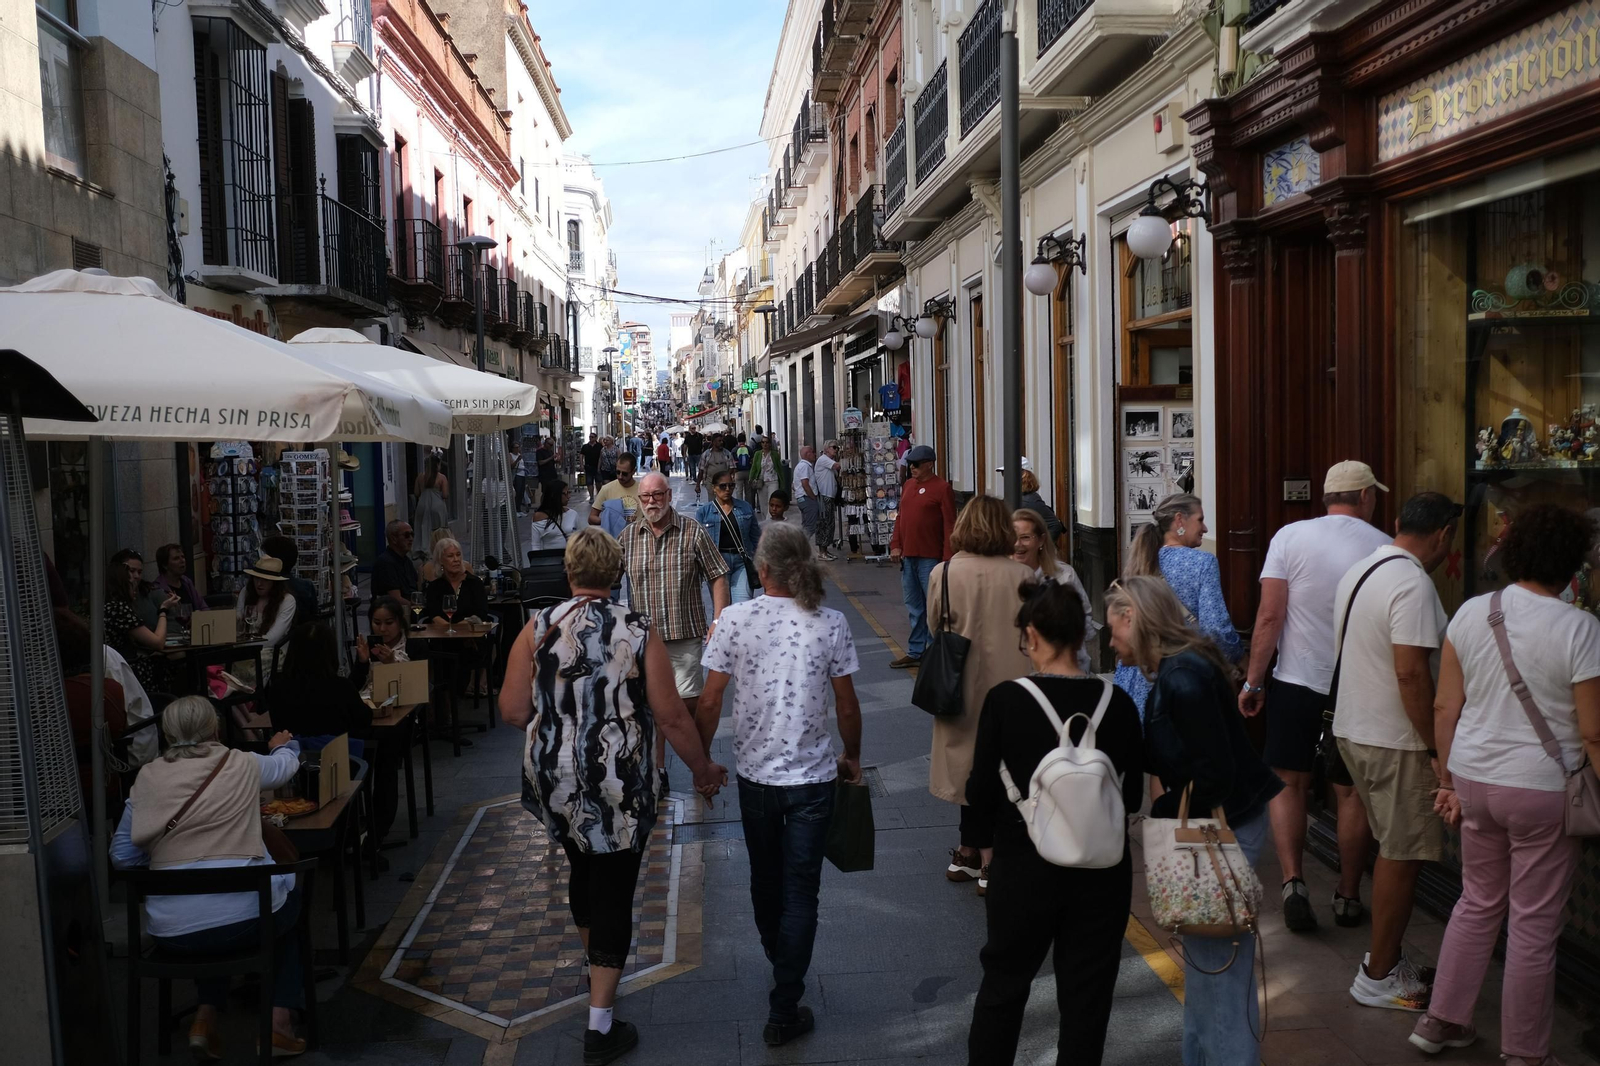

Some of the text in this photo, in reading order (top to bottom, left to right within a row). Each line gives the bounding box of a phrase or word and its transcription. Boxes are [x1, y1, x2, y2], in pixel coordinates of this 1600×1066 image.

[1407, 17, 1600, 144] Decoración
[441, 399, 521, 410] ECHA SIN PRISA
[150, 406, 211, 424] HECHA
[218, 408, 249, 426] SIN
[257, 410, 311, 429] PRISA
